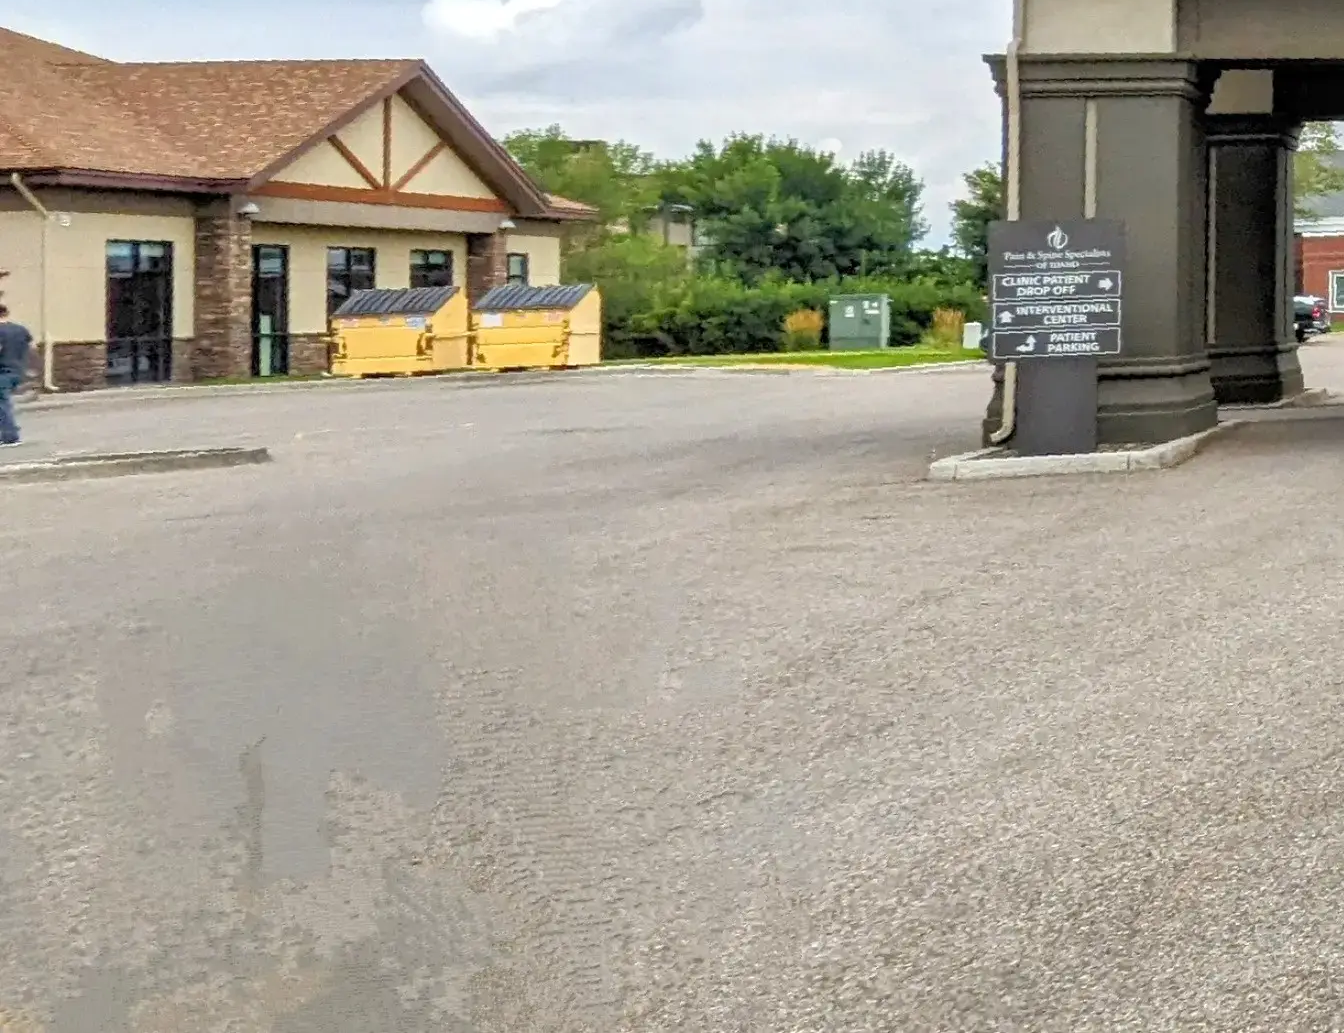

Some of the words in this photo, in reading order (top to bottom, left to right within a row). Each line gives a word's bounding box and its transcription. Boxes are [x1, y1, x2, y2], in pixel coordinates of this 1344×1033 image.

[1002, 276, 1040, 287] CLINIC
[1042, 274, 1091, 285] PATIENT
[1016, 286, 1051, 297] DROP
[1052, 285, 1076, 296] OFF
[1016, 304, 1113, 316] INTERVENTIONAL
[1043, 314, 1088, 325] CENTER
[1050, 332, 1098, 343] PATIENT
[1047, 342, 1100, 353] PARKING
